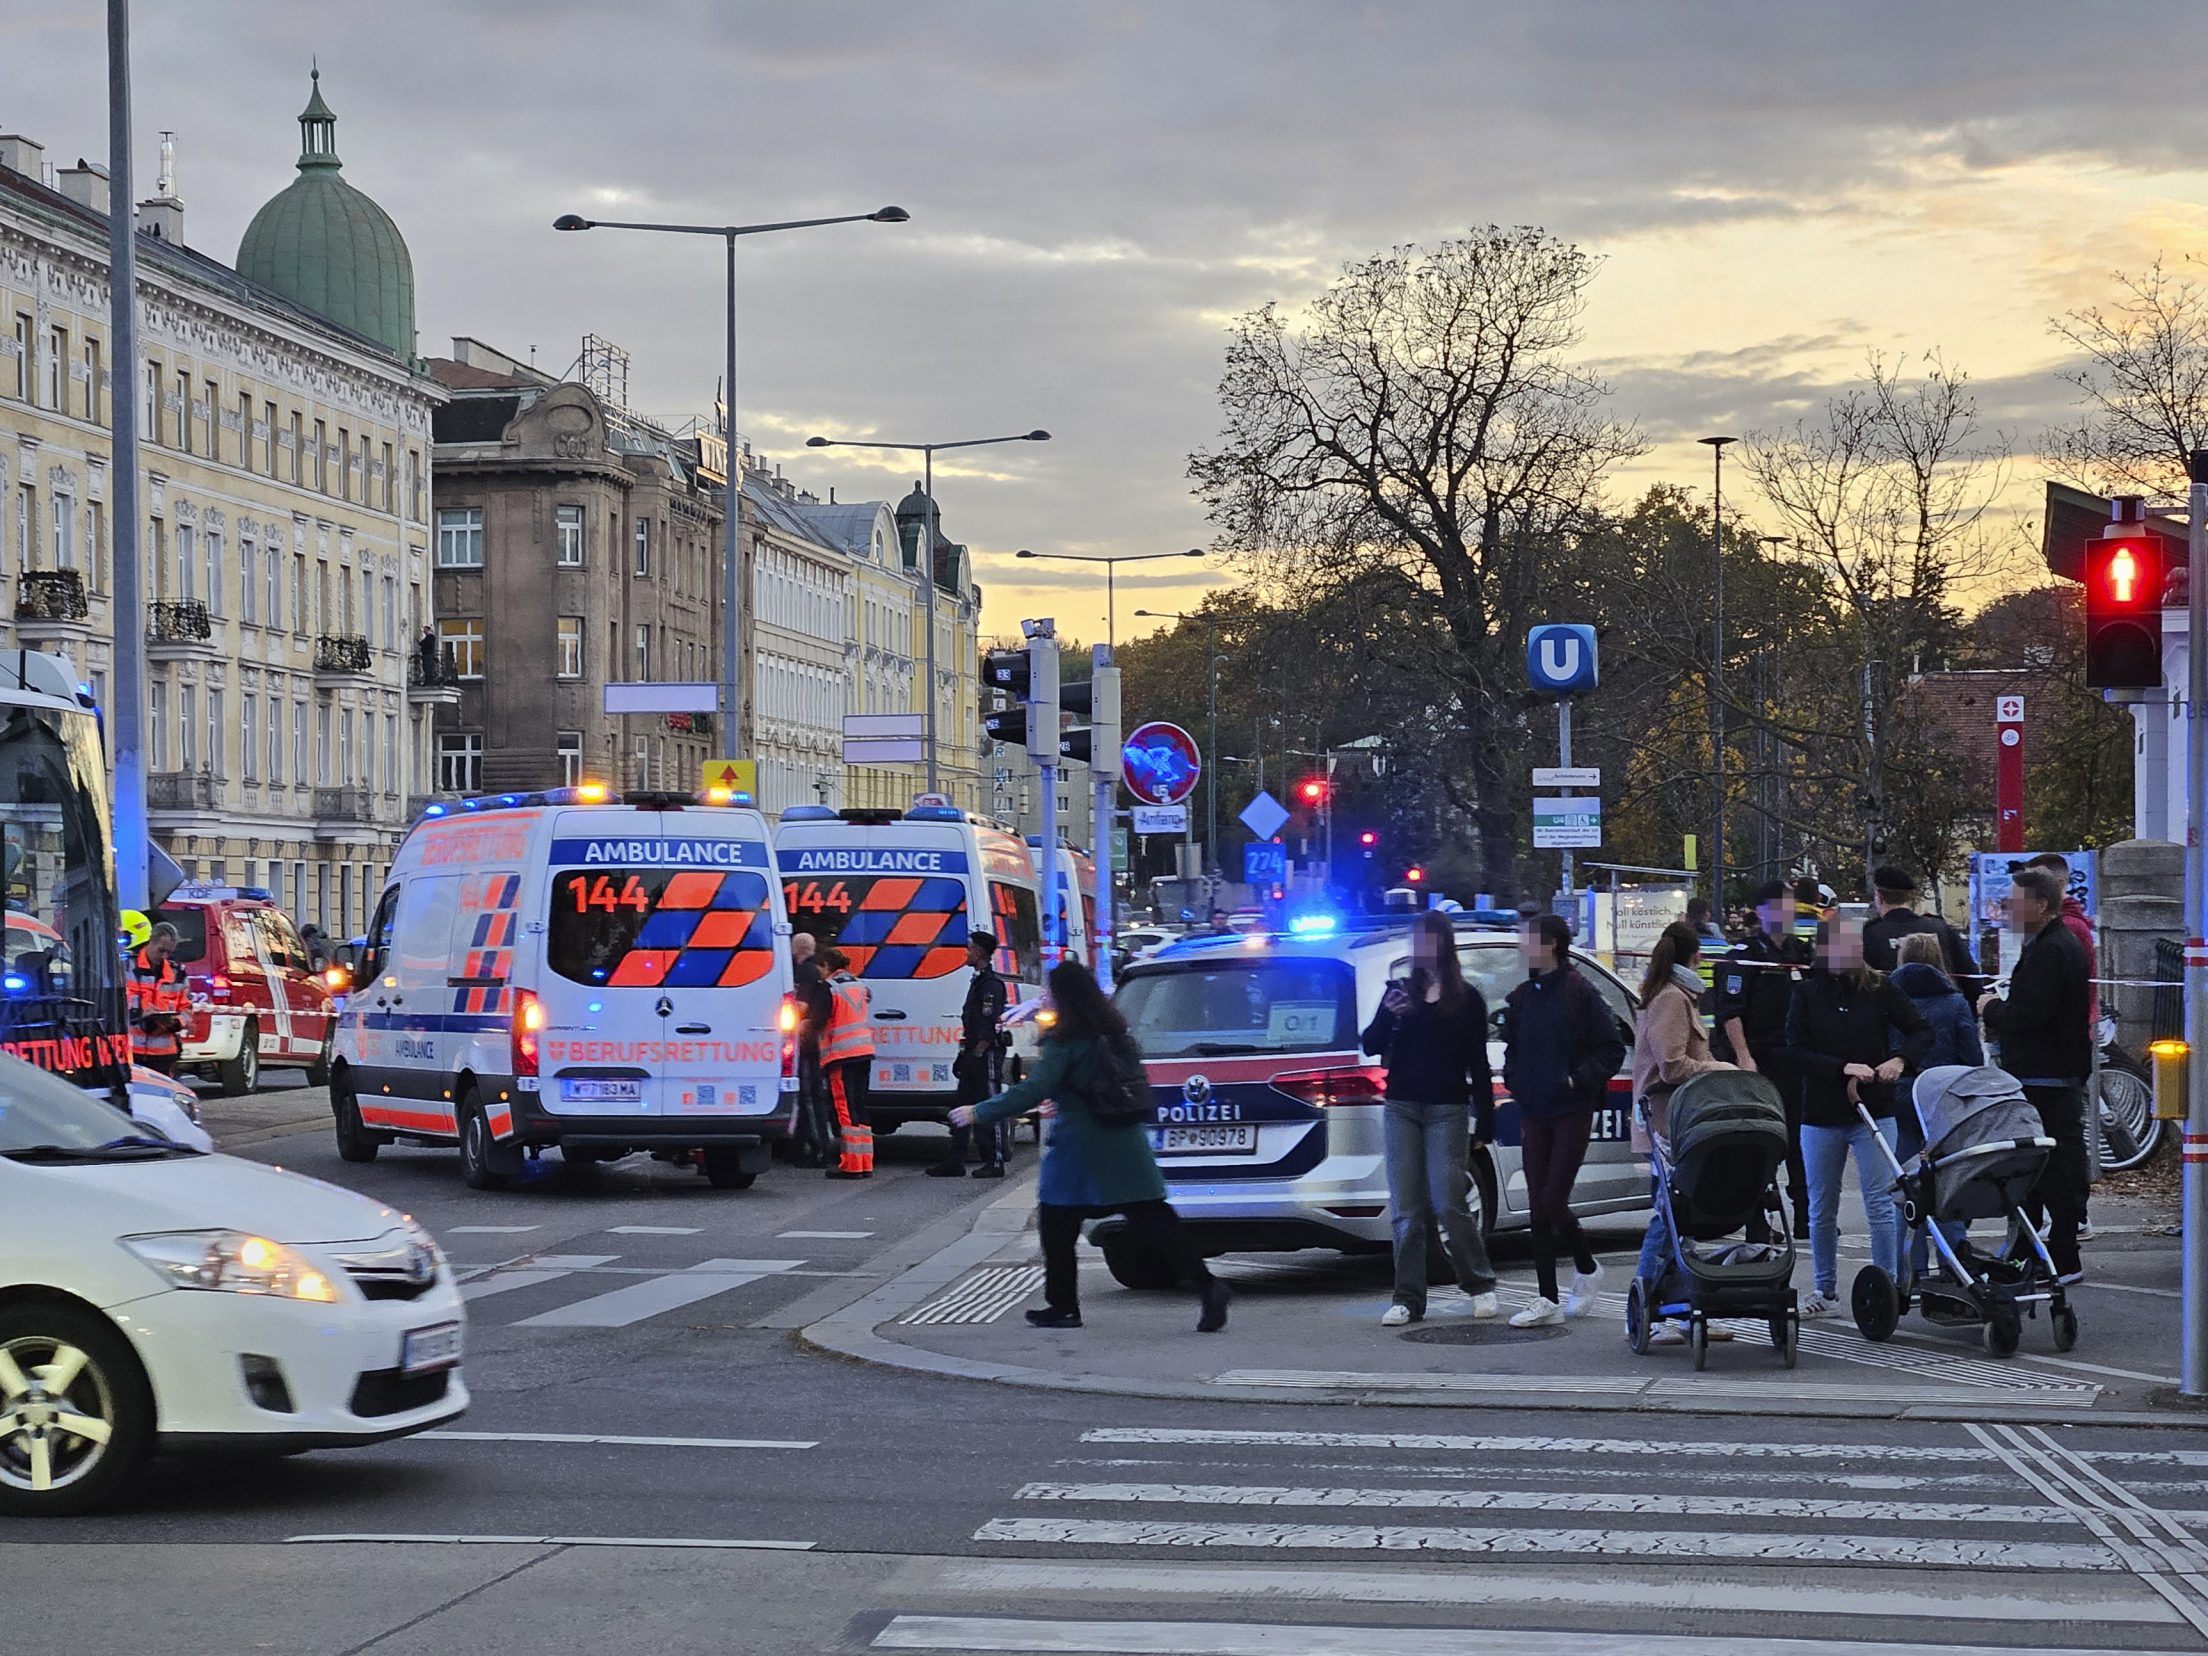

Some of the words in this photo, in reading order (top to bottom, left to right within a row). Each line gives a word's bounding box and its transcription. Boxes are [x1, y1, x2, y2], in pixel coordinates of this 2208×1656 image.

[1541, 639, 1579, 681] U
[585, 842, 742, 864] AMBULANCE
[799, 852, 941, 871] AMBULANCE
[189, 889, 211, 899] KDF
[568, 875, 649, 913] 144
[783, 881, 852, 914] 144
[394, 1039, 434, 1060] AMBULANCE
[568, 1040, 777, 1063] BERUFSRETTUNG
[1157, 1104, 1241, 1123] POLIZEI
[1199, 1128, 1247, 1147] 90978
